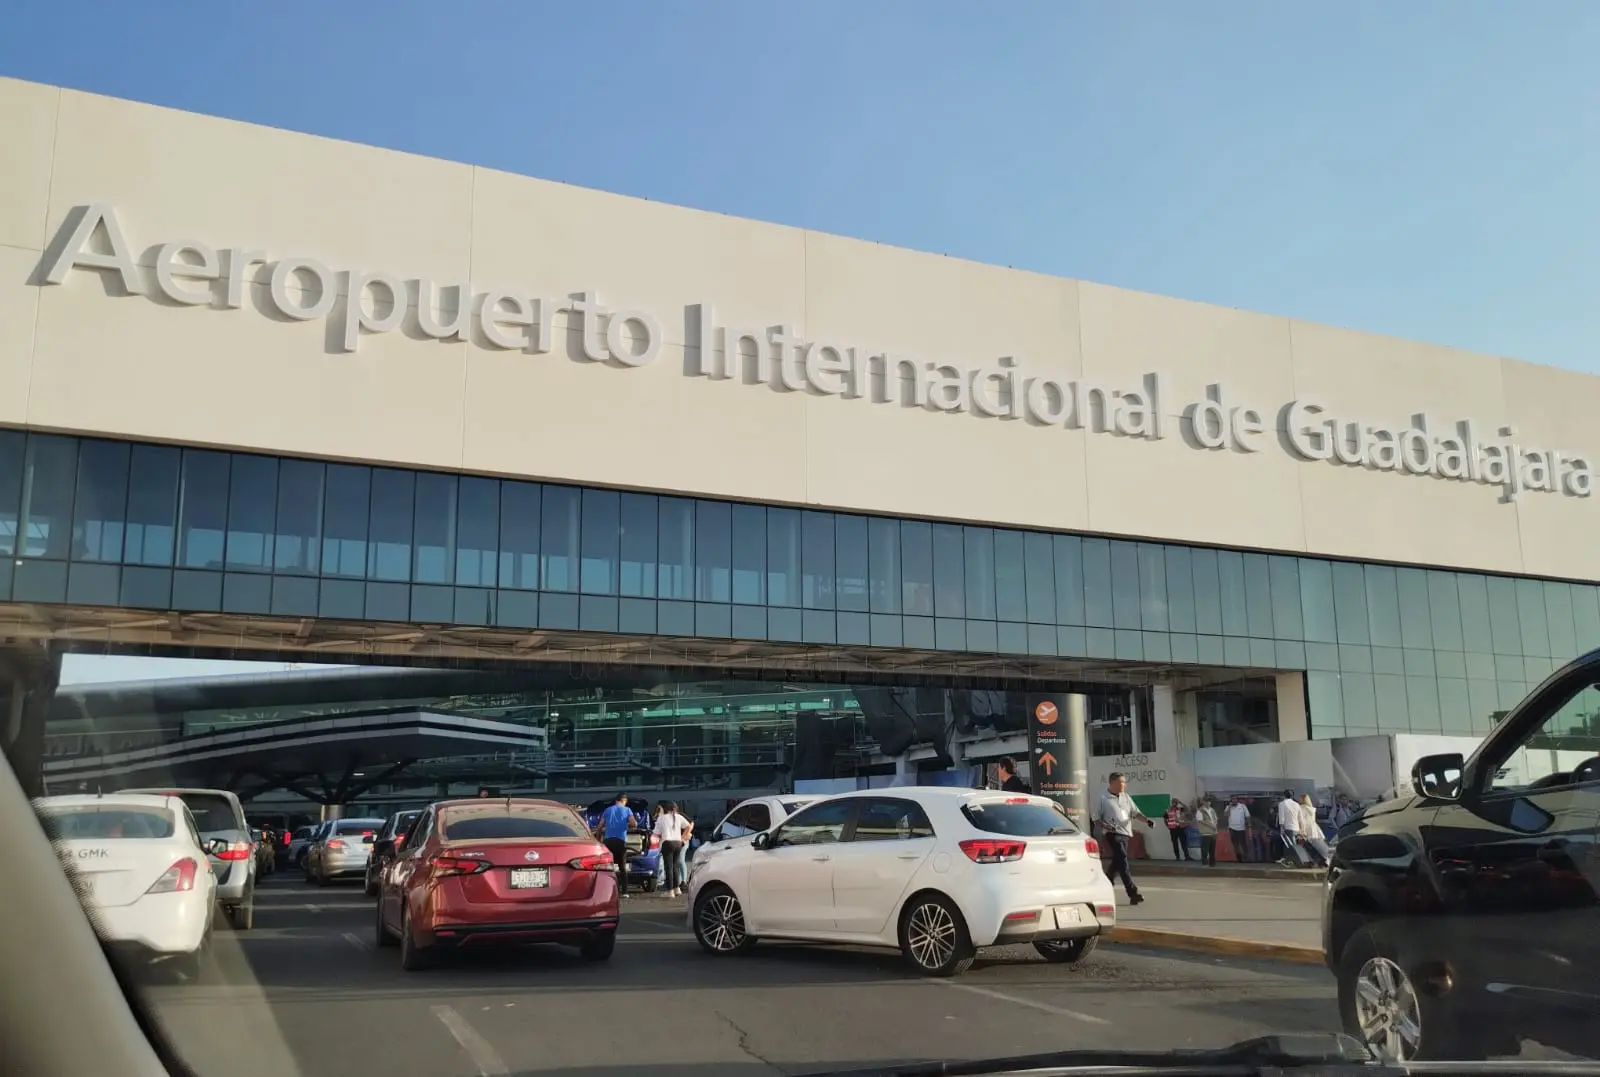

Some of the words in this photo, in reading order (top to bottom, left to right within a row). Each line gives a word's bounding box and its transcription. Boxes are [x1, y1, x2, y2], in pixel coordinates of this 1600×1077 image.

[43, 201, 664, 368] Aeropuerto
[686, 301, 1167, 441] Internacional
[1185, 383, 1263, 453] de
[1280, 399, 1593, 503] Guadalajara
[1115, 755, 1149, 768] ACCESO
[78, 848, 111, 859] GMK
